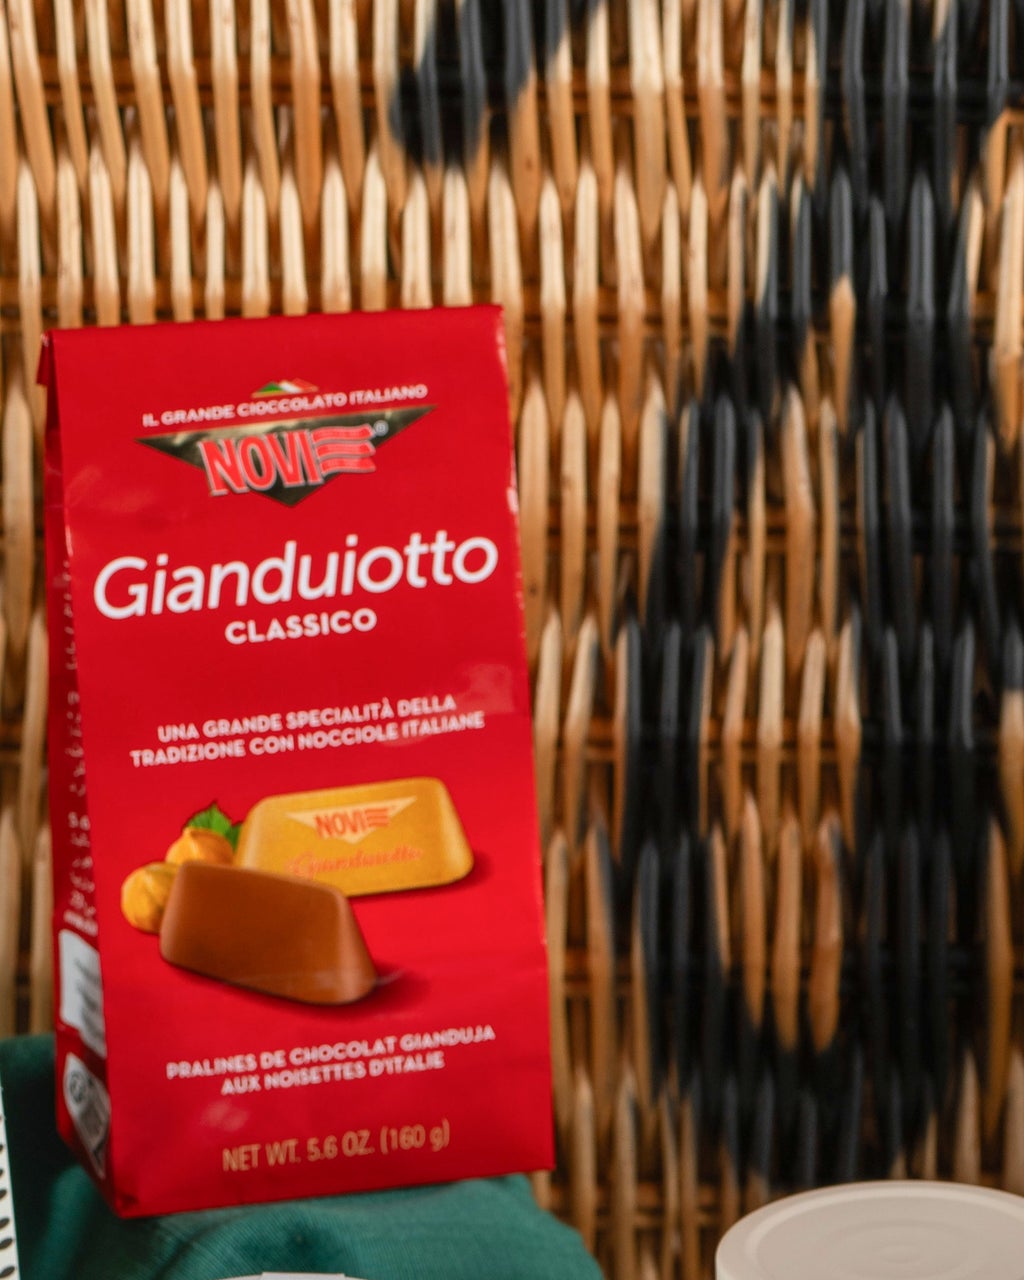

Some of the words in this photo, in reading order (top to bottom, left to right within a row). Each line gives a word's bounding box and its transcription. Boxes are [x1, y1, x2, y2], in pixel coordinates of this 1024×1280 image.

[142, 413, 160, 428] IL
[160, 404, 236, 426] GRANDE
[236, 391, 347, 417] CIOCCOLATO
[349, 384, 428, 406] ITALIANO
[93, 530, 499, 620] Gianduiotto
[224, 607, 377, 644] CLASSICO
[130, 739, 246, 768] TRADIZIONE
[249, 733, 295, 755] CON
[297, 722, 399, 749] NOCCIOLE
[401, 711, 485, 737] ITALIANE
[157, 722, 200, 743] UNA
[202, 713, 283, 738] GRANDE
[286, 697, 395, 728] SPECIALITÀ
[397, 694, 456, 714] DELLA
[166, 1050, 257, 1080] PRALINES
[260, 1044, 287, 1068] DE
[289, 1035, 396, 1066] CHOCOLAT
[399, 1025, 496, 1052] GIANDUJA
[221, 1076, 261, 1095] AUX
[264, 1061, 366, 1090] NOISETTES
[369, 1051, 445, 1078] D'ITALIE
[222, 1145, 262, 1172] NET
[266, 1141, 301, 1166] WT.
[306, 1135, 338, 1160] 5.6
[342, 1130, 376, 1155] OZ.
[379, 1125, 425, 1155] (160
[429, 1119, 451, 1152] g)
